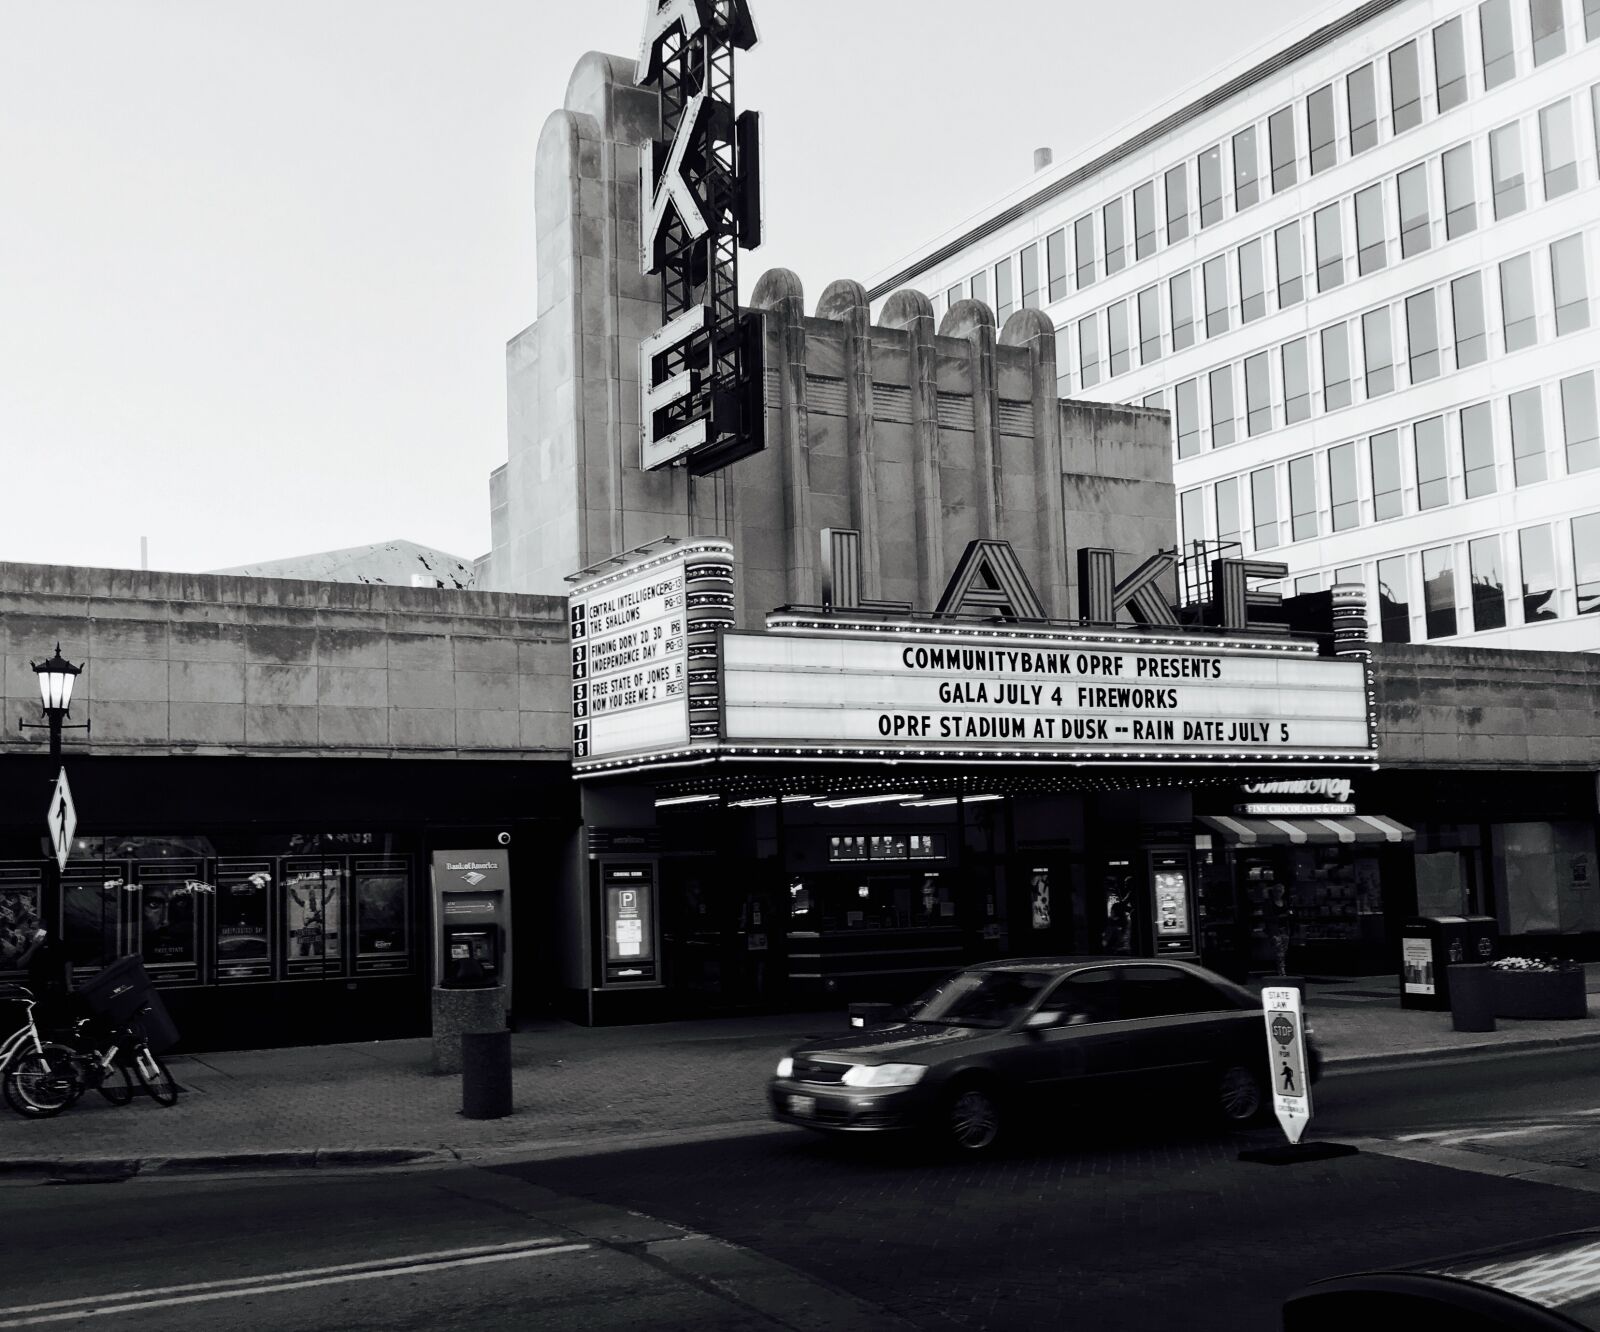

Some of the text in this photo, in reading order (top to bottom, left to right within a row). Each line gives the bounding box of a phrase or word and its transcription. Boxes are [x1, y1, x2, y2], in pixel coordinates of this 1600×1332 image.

[821, 527, 1290, 634] LAKE
[575, 579, 682, 620] 1 CENTRAL INTELLIGENCE PG-13
[575, 595, 682, 637] 2 THE SHALLOWS PG-13
[577, 622, 680, 661] 3 FINDING DORY 2D 3D PG
[576, 639, 683, 677] 4 INDEPENDENCE DAY PG-13
[1076, 654, 1123, 676] OPRF
[1137, 657, 1221, 679] PRESENTS
[577, 665, 682, 699] 5 FREE STATE OF JONES R
[939, 682, 1178, 708] GALA JULY 4 FIREWORKS
[577, 683, 684, 716] 6 NOW YOU SEE ME 2 PG-13
[578, 725, 584, 739] 7
[879, 714, 931, 736] OPRF
[940, 716, 1025, 738] STADIUM
[1033, 718, 1055, 738] AT
[1062, 718, 1108, 740] DUSK
[1133, 720, 1174, 740] RAIN
[1183, 721, 1224, 741] DATE
[1228, 722, 1269, 742] JULY
[1281, 723, 1289, 742] 5
[578, 742, 584, 756] 8
[1269, 804, 1321, 813] CHOCOLATES
[1331, 804, 1355, 813] GIFTS
[464, 862, 471, 870] of
[471, 862, 498, 870] America
[622, 893, 633, 906] P
[1268, 992, 1290, 1000] STATE
[1273, 1025, 1293, 1036] STOP
